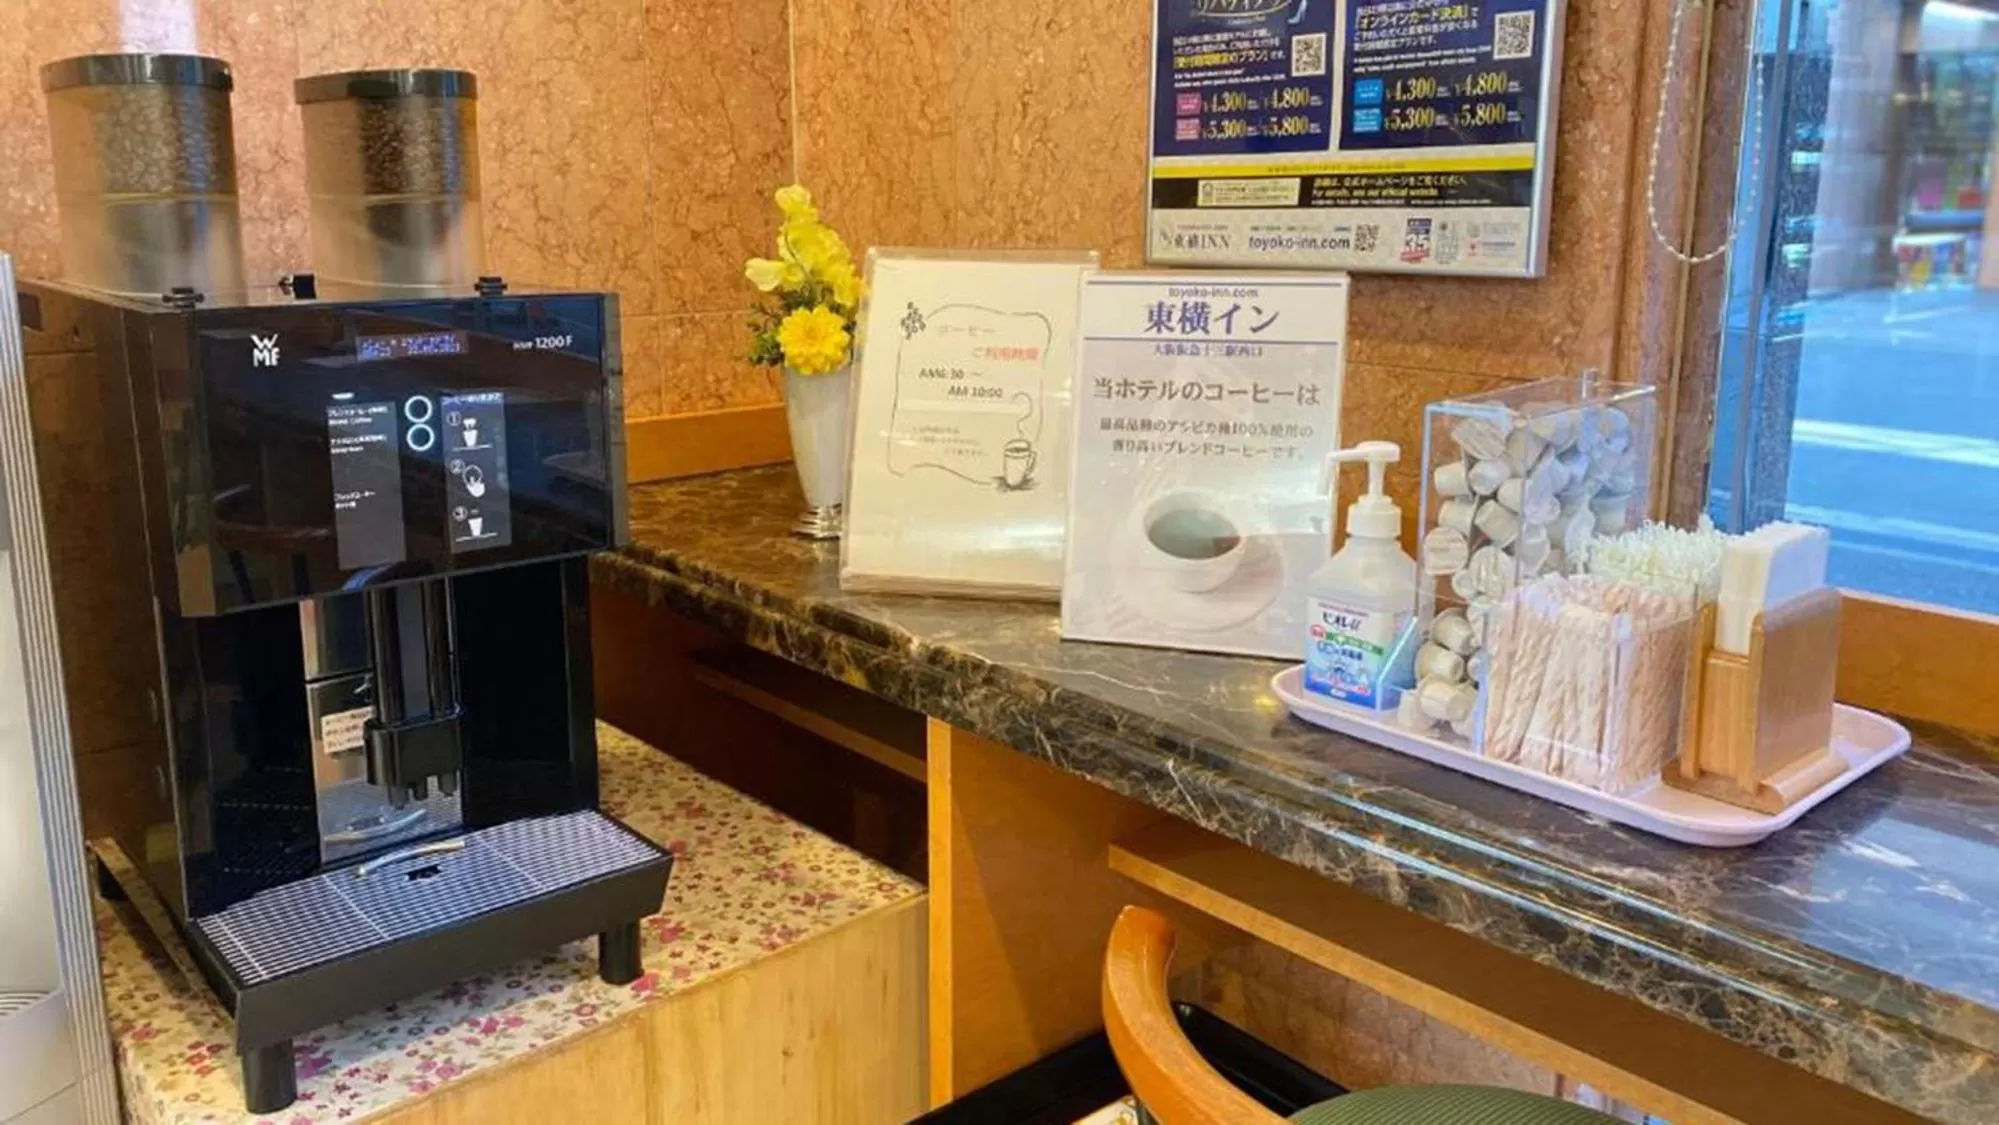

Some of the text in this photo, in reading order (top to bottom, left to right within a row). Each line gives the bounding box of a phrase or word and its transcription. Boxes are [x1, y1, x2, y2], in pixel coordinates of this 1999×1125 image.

[1249, 235, 1350, 251] toyoko-inn.com
[1168, 286, 1259, 299] toyoko-inn.com
[1144, 301, 1280, 335] 東横イン
[938, 324, 997, 337] コーヒー
[250, 333, 281, 368] WMF
[948, 385, 1004, 399] AM 10:00
[1093, 376, 1321, 406] 当ホテルのコーヒーは
